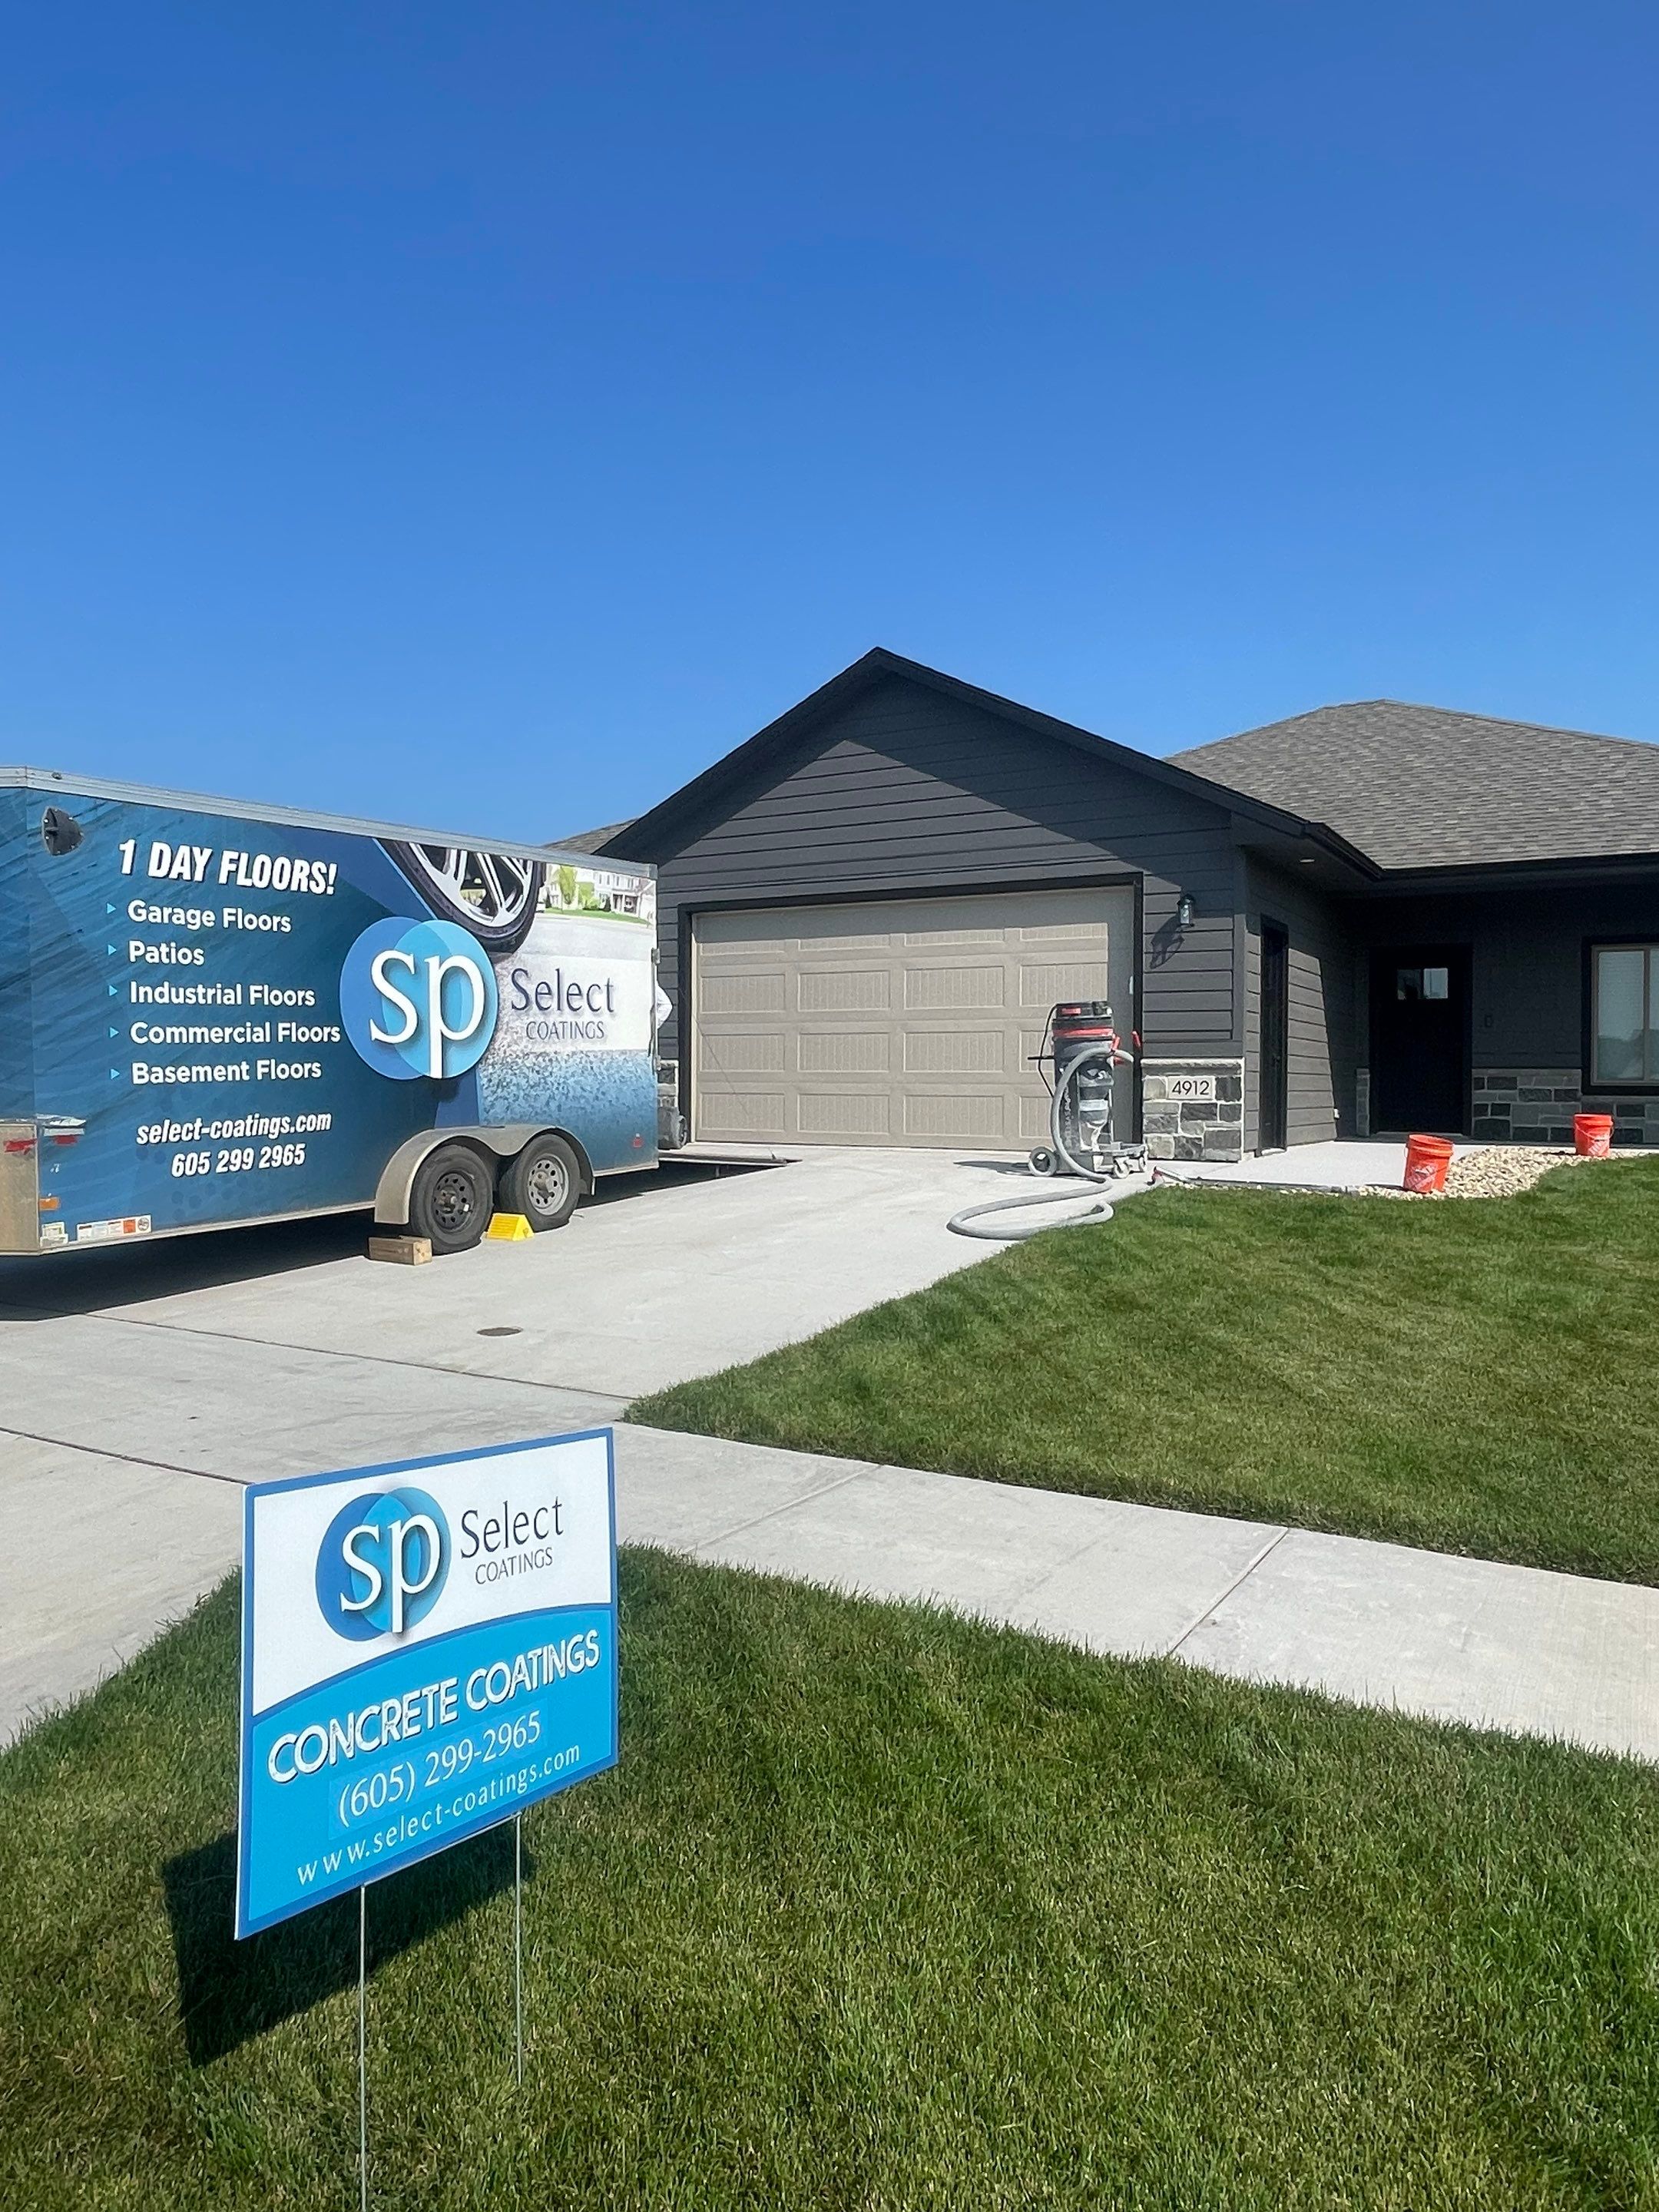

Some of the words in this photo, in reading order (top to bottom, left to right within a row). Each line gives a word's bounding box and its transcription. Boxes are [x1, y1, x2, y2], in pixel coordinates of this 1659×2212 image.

[119, 839, 136, 875] 1
[147, 841, 213, 882] DAY
[218, 850, 338, 895] FLOORS!
[127, 899, 216, 931] Garage
[223, 908, 292, 932] Floors
[128, 941, 205, 965] Patios
[130, 982, 242, 1005] Industrial
[249, 985, 316, 1006] Floors
[511, 968, 614, 1013] Select
[131, 1021, 271, 1045] Commercial
[277, 1022, 341, 1043] Floors
[526, 1020, 605, 1040] COATINGS
[131, 1061, 250, 1085] Basement
[257, 1059, 322, 1081] Floors
[1172, 1080, 1209, 1095] 4912
[136, 1113, 333, 1146] select-coatings.com
[171, 1151, 210, 1178] 605
[215, 1147, 254, 1174] 299
[260, 1143, 306, 1169] 2965
[460, 1495, 565, 1559] Select
[475, 1548, 554, 1584] COATINGS
[267, 1676, 459, 1783] CONCRETE
[465, 1629, 601, 1711] COATINGS
[339, 1768, 416, 1826] (605)
[424, 1710, 541, 1786] 299-2965
[296, 1743, 581, 1886] www.select-coatings.com
